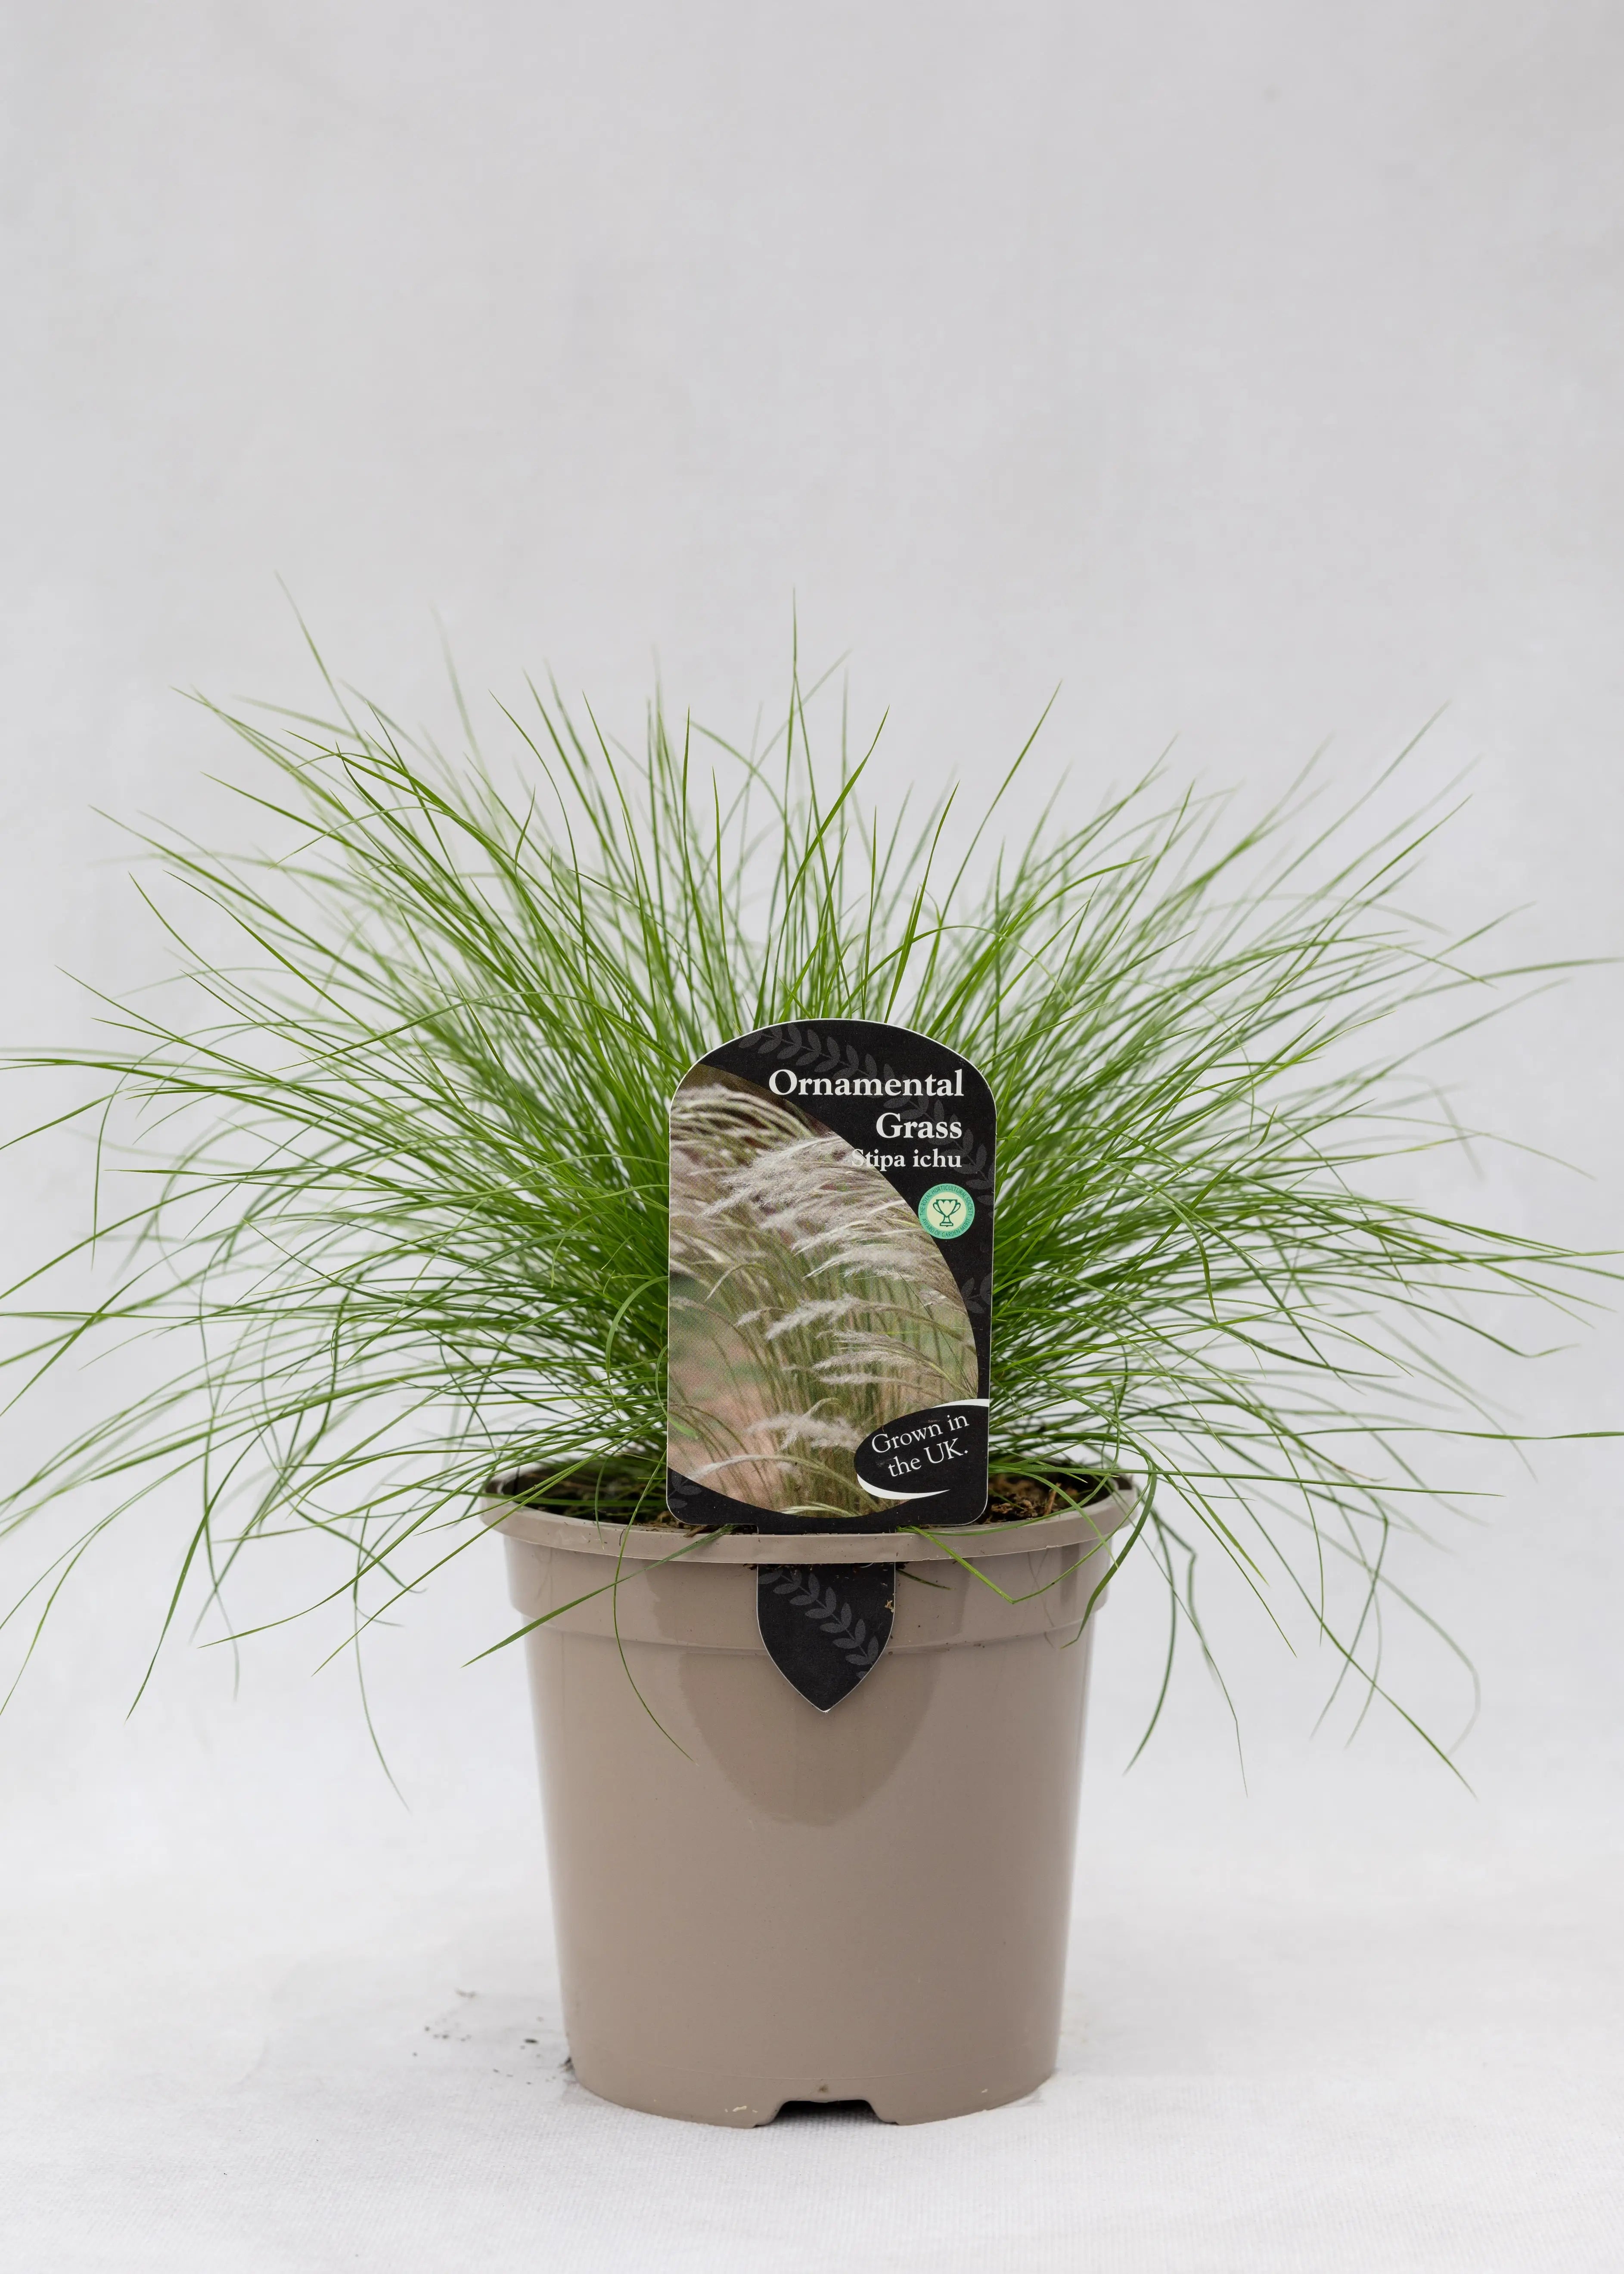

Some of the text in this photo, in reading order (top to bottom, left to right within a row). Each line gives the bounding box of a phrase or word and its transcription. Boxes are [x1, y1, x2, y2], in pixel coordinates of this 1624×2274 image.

[769, 1069, 964, 1096] Ornamental
[876, 1112, 962, 1139] Grass
[851, 1149, 962, 1172] Stipa ichu
[922, 1192, 932, 1207] ROYAL
[932, 1185, 966, 1198] HORTICULTURAL
[965, 1197, 973, 1217] SOCIETY
[922, 1218, 935, 1233] AWARD
[941, 1229, 961, 1237] GARDEN
[961, 1218, 971, 1232] MERIT
[872, 1415, 970, 1453] Grown in
[888, 1437, 968, 1477] the UK.
